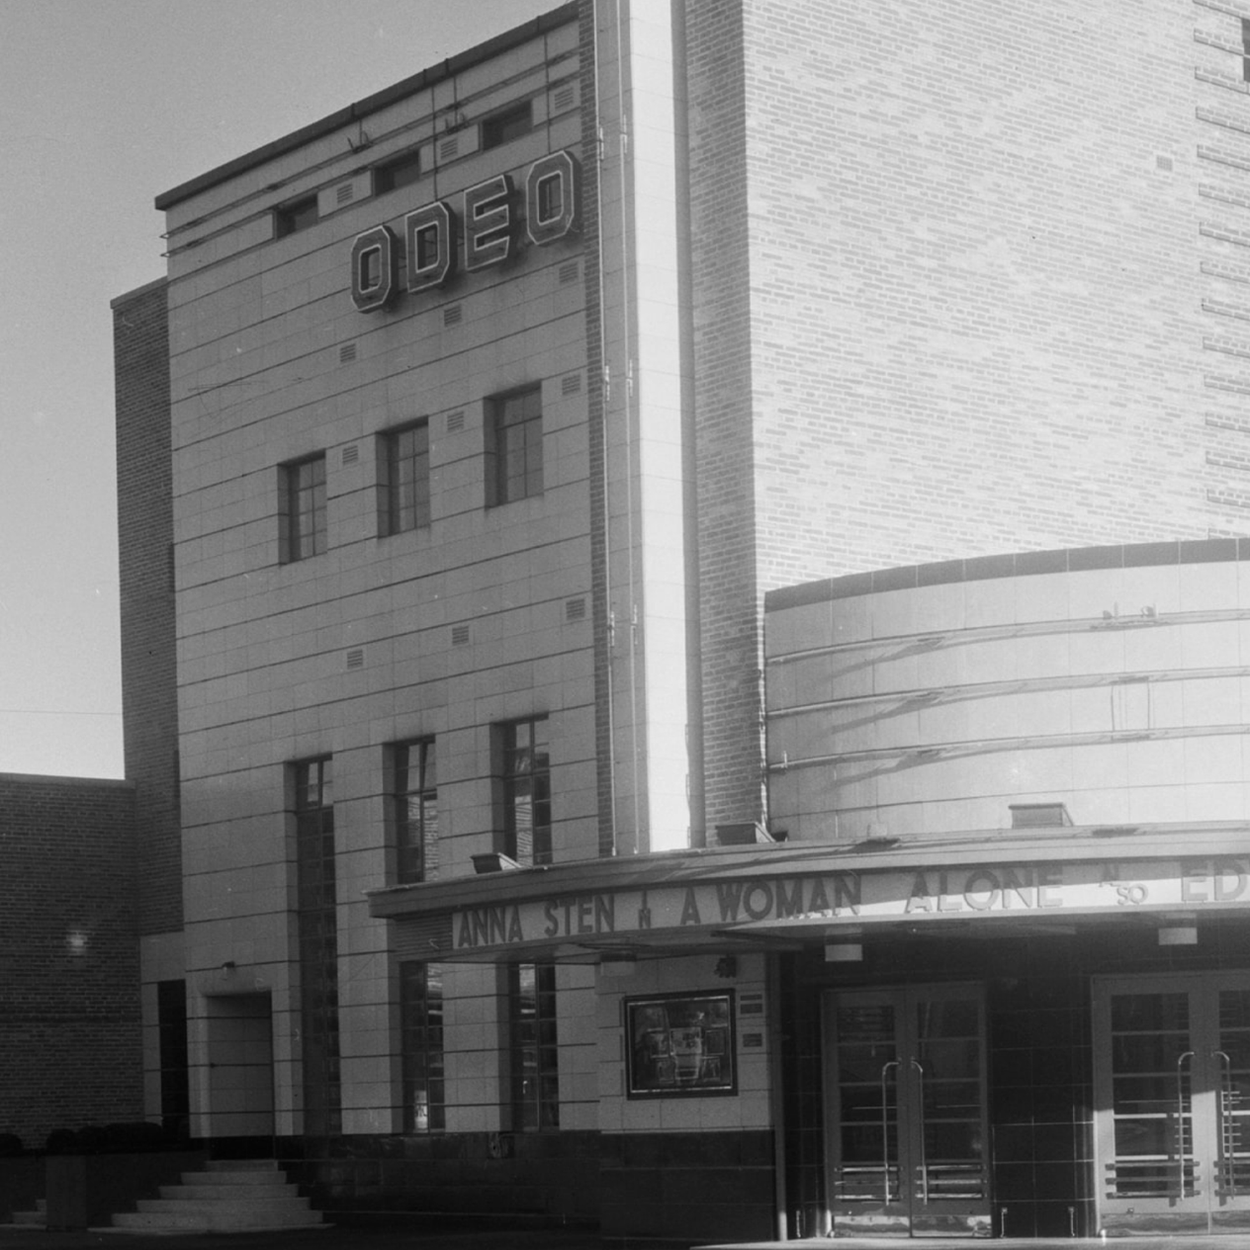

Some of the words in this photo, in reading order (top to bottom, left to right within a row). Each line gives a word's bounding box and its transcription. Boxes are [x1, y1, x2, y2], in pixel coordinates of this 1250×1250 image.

[457, 904, 524, 948] ANNA
[544, 892, 616, 938] STEN
[680, 883, 702, 925] A
[716, 872, 861, 922] WOMAN
[903, 863, 1064, 915] ALONE
